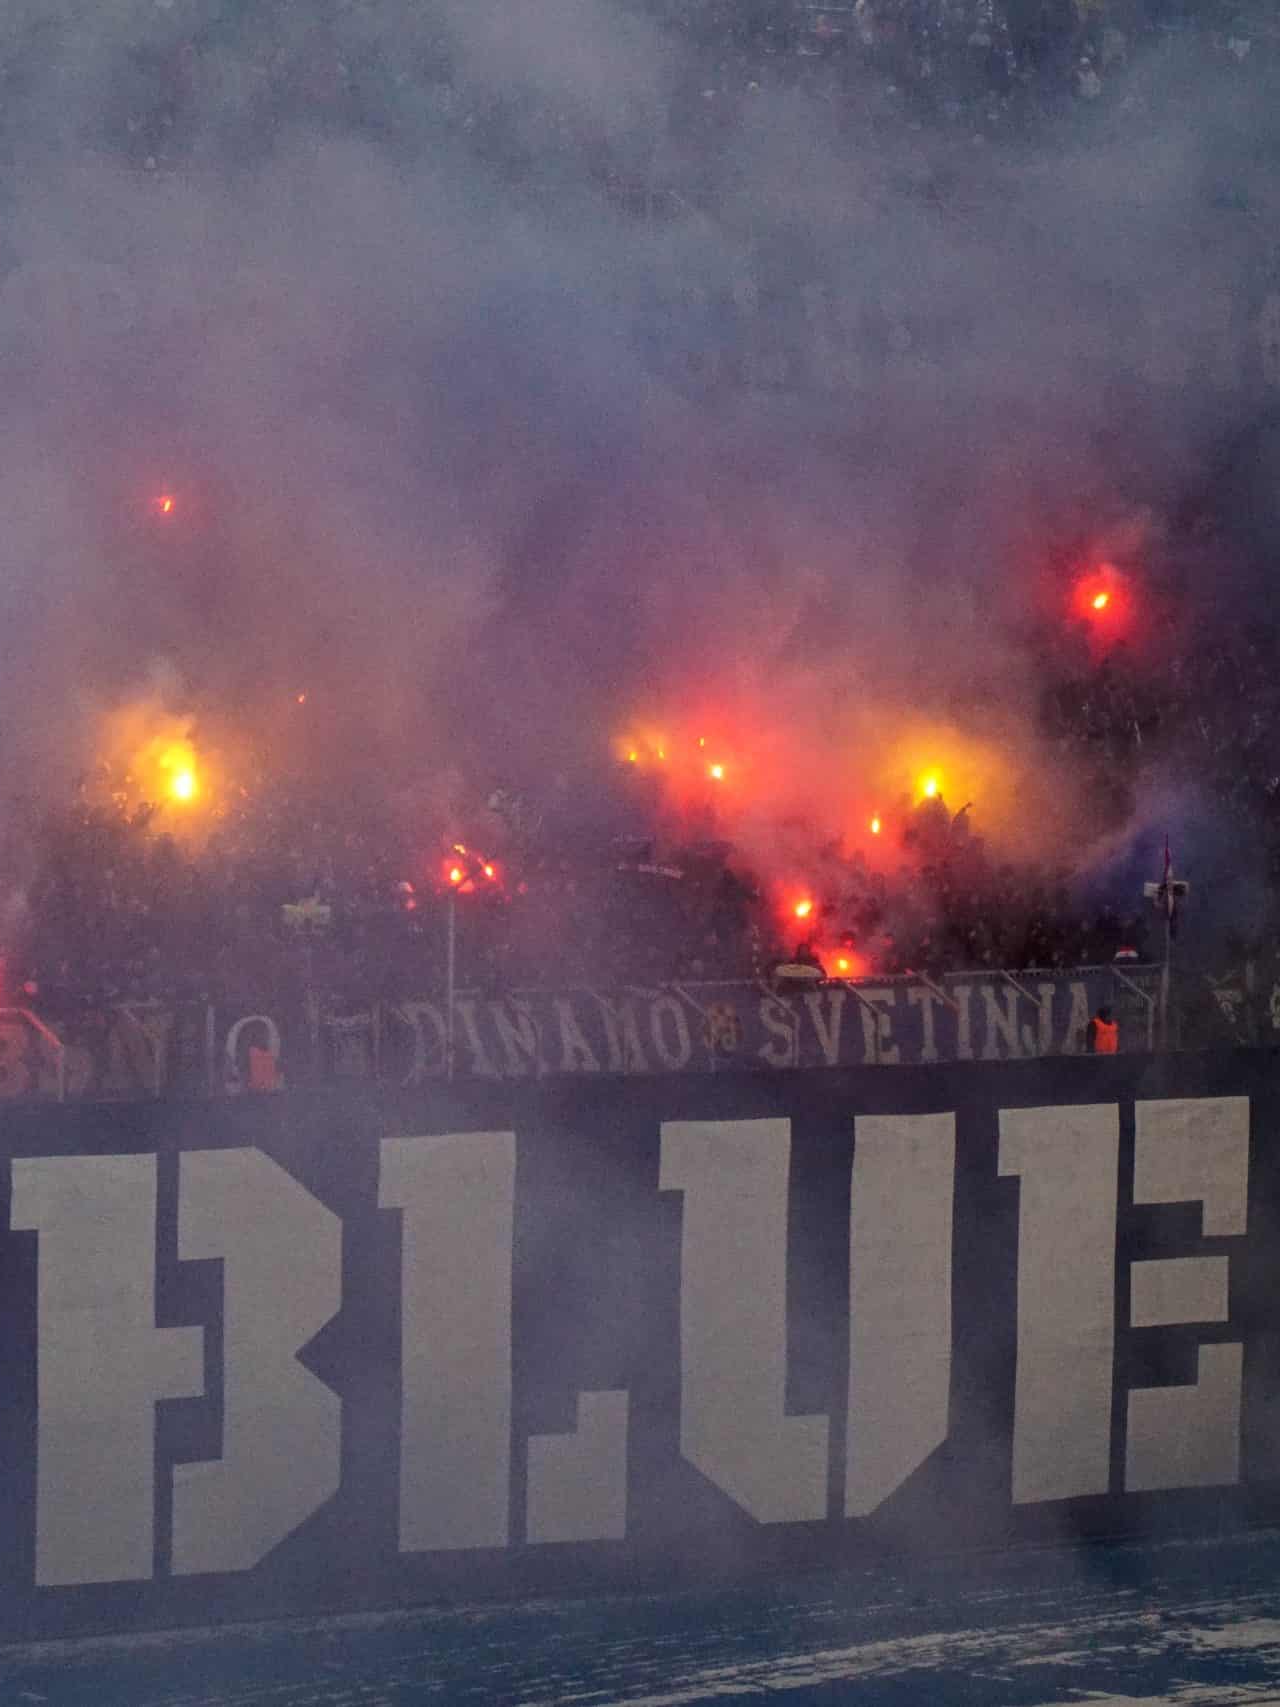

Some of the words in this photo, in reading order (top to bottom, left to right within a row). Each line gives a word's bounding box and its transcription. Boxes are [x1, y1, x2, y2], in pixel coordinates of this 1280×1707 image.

[398, 994, 692, 1087] DINAMO
[758, 981, 1092, 1067] SVETINJA
[10, 1096, 1251, 1586] BLUE
